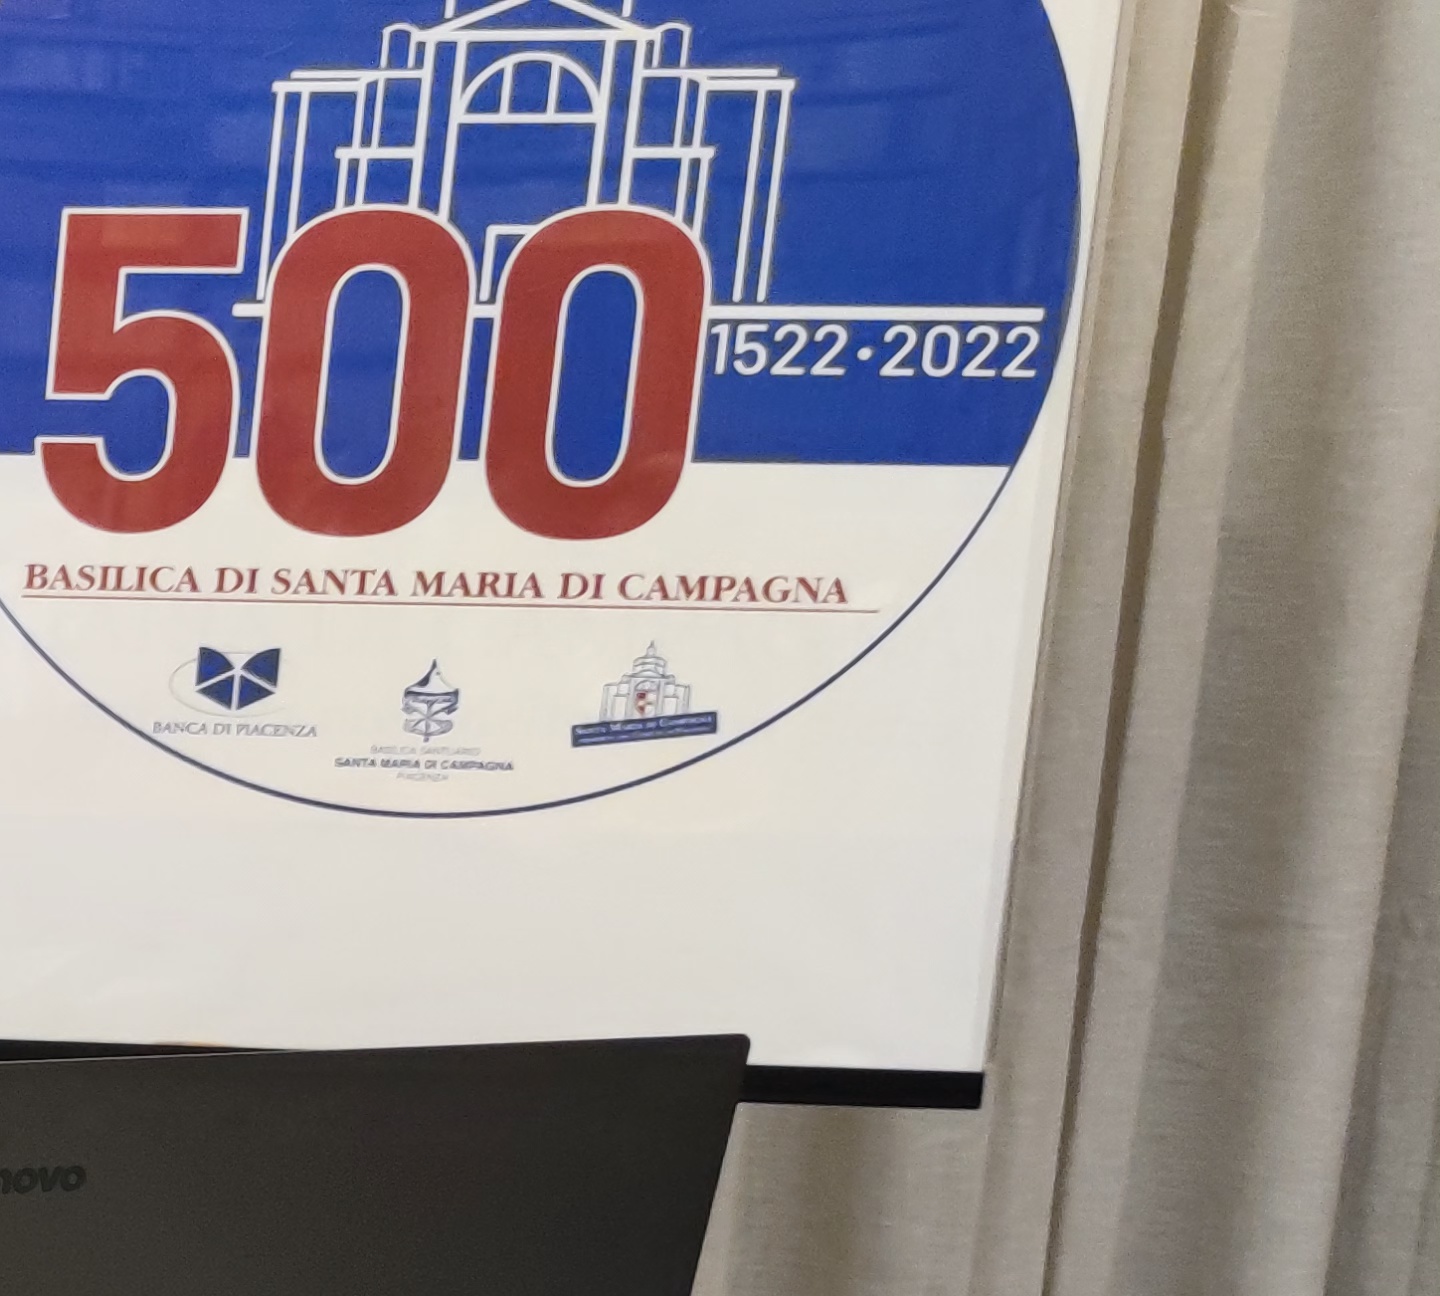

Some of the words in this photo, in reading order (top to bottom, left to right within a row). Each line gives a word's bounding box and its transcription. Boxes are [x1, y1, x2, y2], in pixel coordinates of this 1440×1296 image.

[34, 203, 713, 541] 500
[23, 563, 202, 593] BASILICA
[215, 567, 260, 595] DI
[270, 568, 397, 597] SANTA
[411, 570, 544, 599] MARIA
[556, 572, 606, 601] DI
[617, 573, 849, 605] CAMPAGNA
[152, 722, 208, 735] BANCA
[213, 723, 231, 735] DI
[236, 724, 318, 738] PIACENZA
[334, 757, 377, 768] SANTA
[380, 758, 421, 769] MARIA
[424, 759, 437, 770] DI
[440, 759, 514, 771] CAMPAGNA
